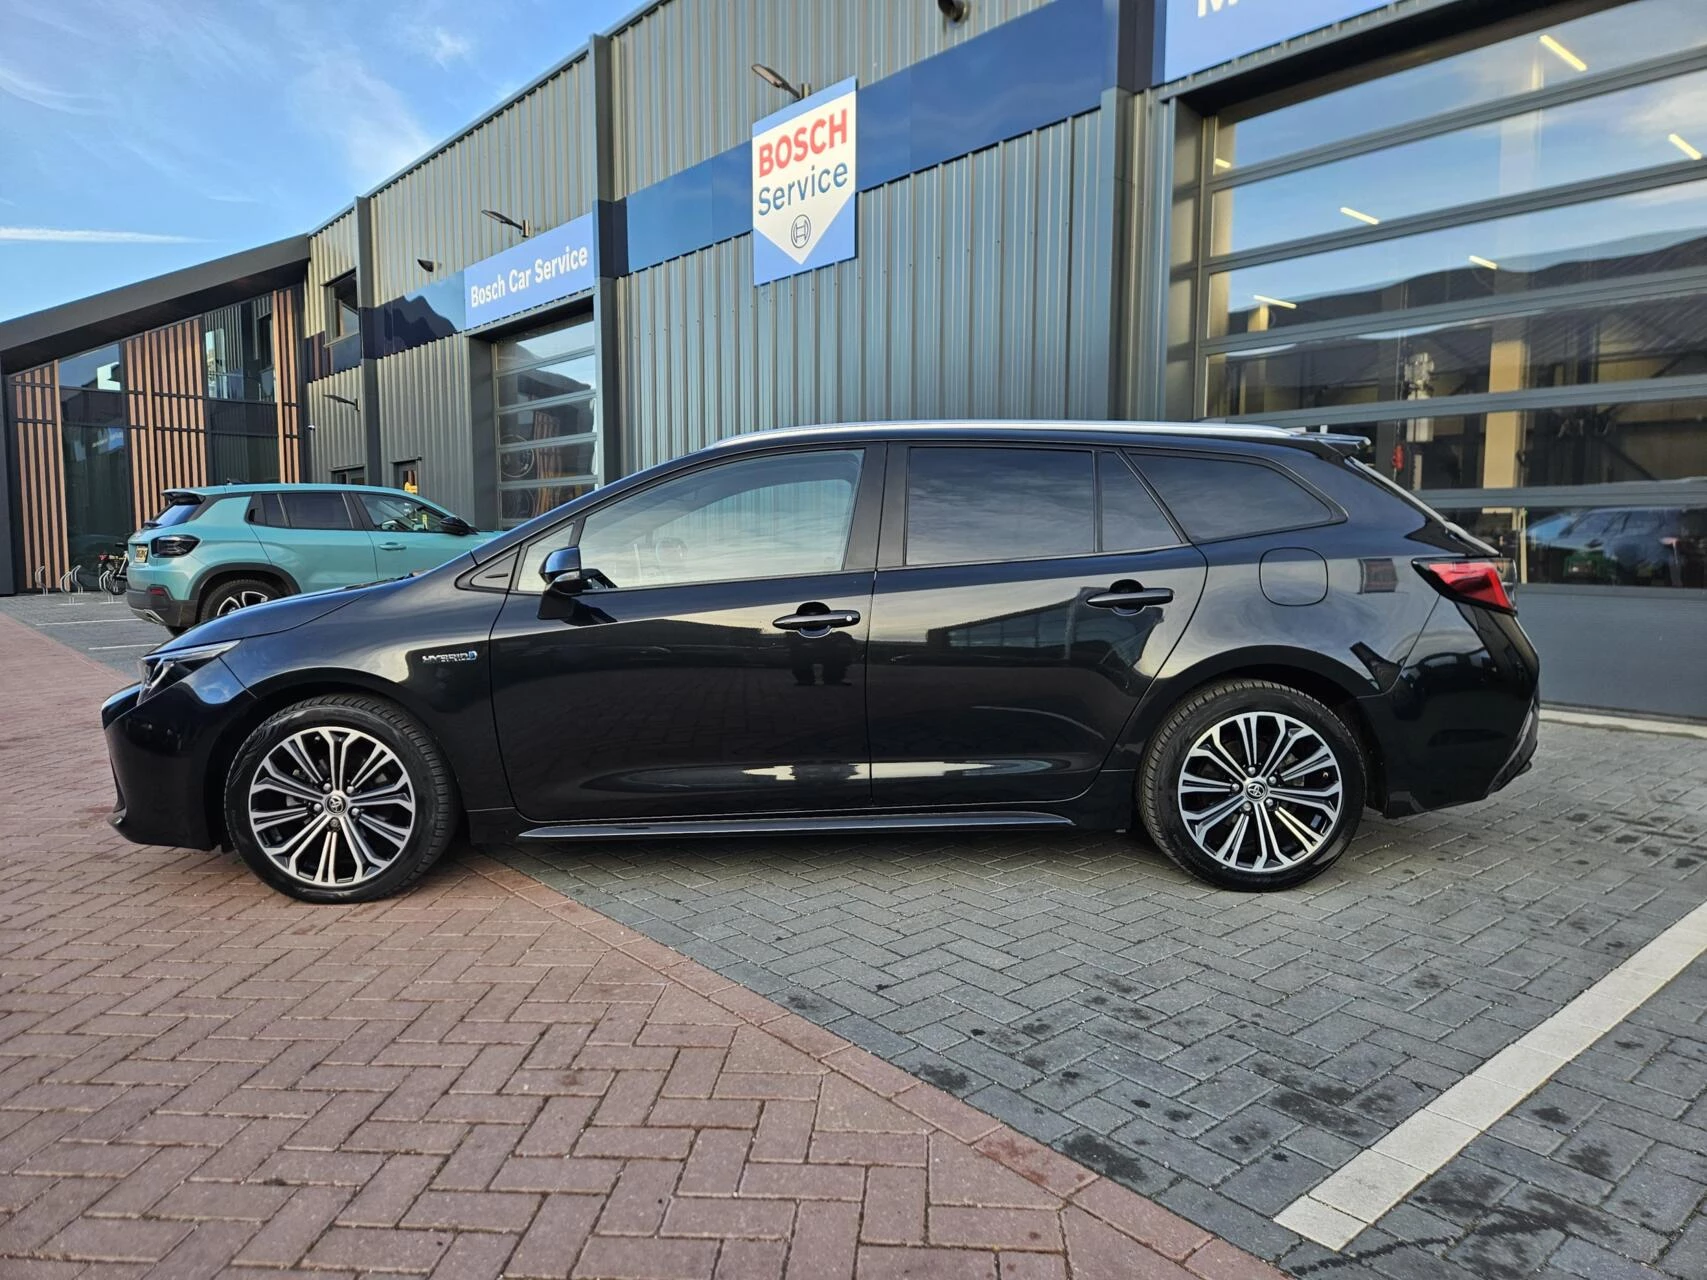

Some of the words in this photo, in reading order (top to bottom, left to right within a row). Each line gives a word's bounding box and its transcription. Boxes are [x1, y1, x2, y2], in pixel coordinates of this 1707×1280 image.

[759, 108, 848, 178] BOSCH
[758, 162, 848, 216] Service
[471, 274, 506, 308] Bosch
[508, 268, 532, 293] Car
[534, 245, 588, 283] Service
